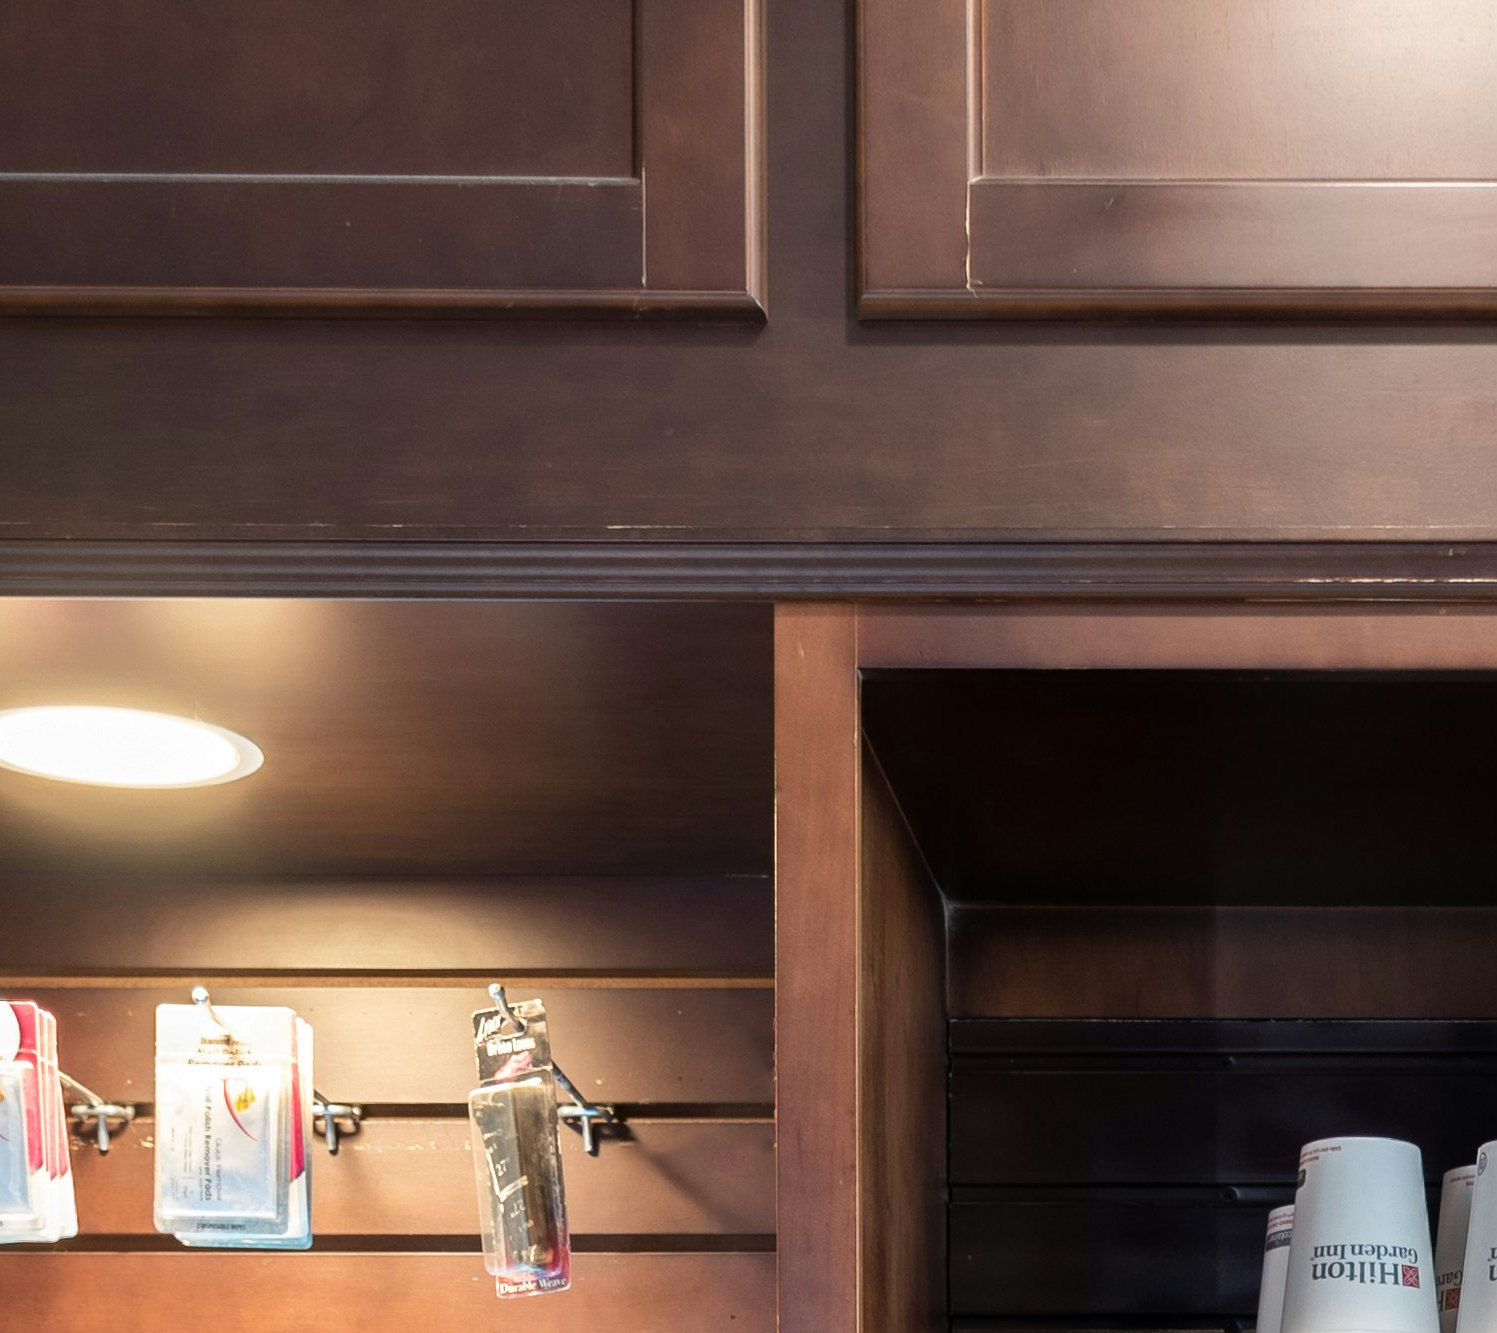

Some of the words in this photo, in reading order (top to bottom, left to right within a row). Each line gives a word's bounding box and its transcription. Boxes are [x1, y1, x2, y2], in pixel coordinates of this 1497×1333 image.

[1312, 1245, 1345, 1260] Inn
[1350, 1246, 1418, 1264] Garden
[1311, 1261, 1401, 1286] Hilton
